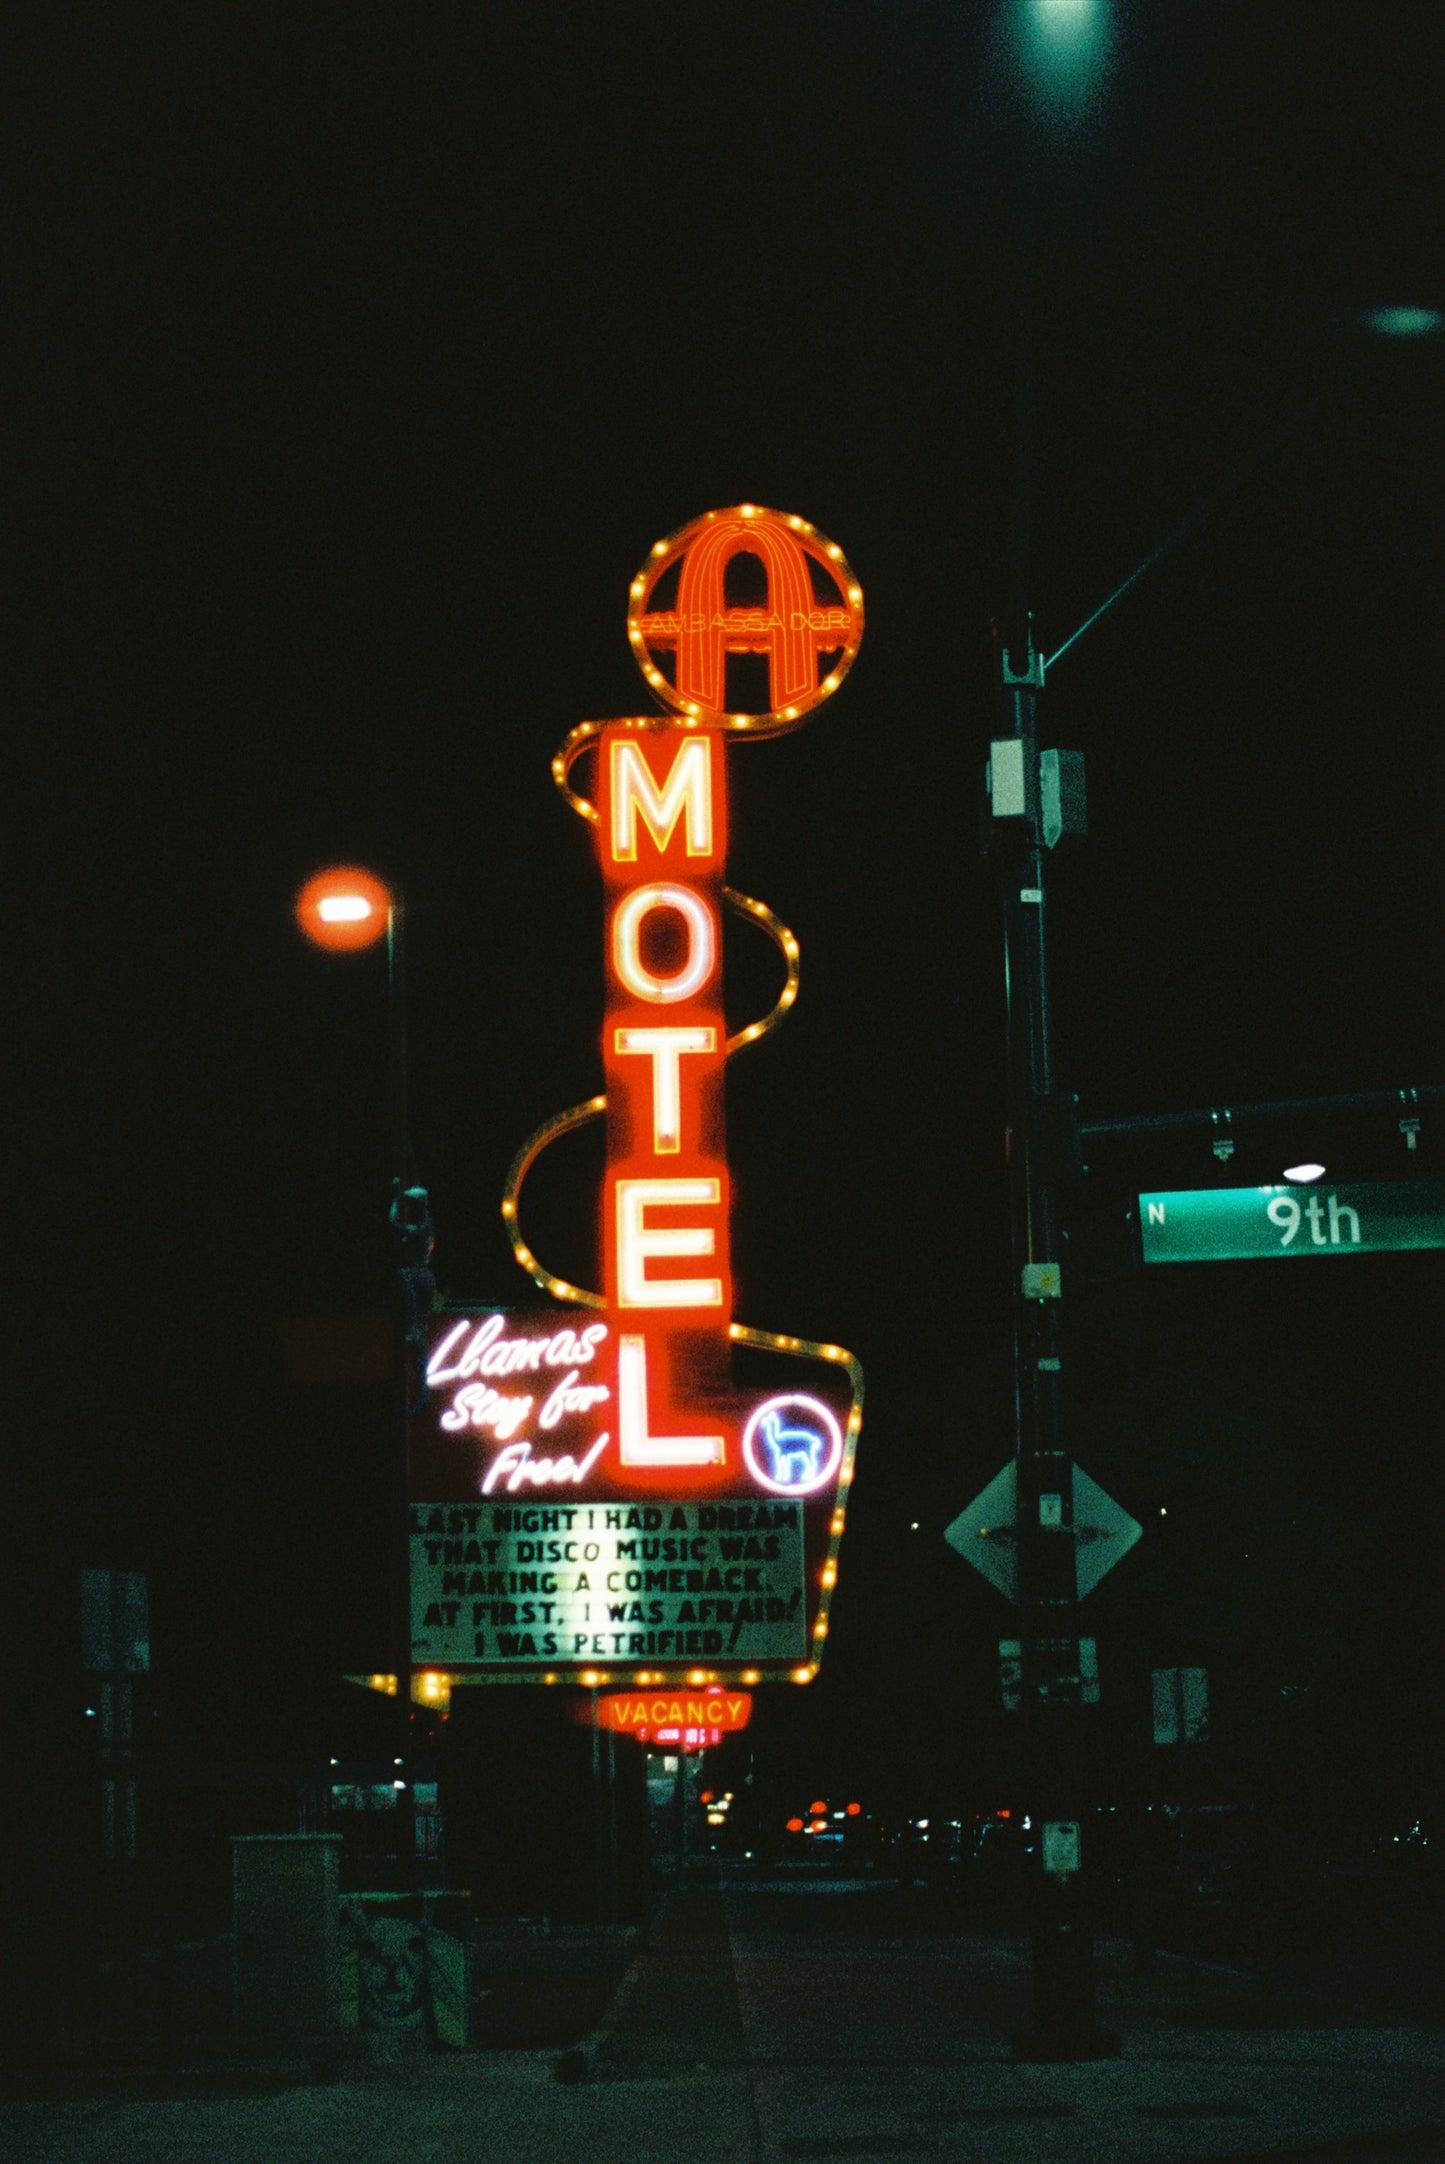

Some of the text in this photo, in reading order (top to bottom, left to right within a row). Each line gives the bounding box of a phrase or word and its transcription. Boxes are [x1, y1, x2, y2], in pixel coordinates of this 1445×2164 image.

[648, 612, 848, 633] AMBASSADOR
[607, 732, 727, 1468] MOTEL
[1147, 1194, 1361, 1247] N 9th
[425, 1313, 609, 1386] Llamas
[538, 1369, 610, 1430] for
[410, 1505, 799, 1533] LAST NIGHT I HAD A DREAM
[423, 1534, 781, 1565] THAT DISCO MUSIC WAS
[443, 1567, 775, 1596] MAKING A COMEBACK.
[423, 1601, 460, 1627] AT
[585, 1603, 591, 1622] I
[606, 1600, 664, 1624] WAS
[677, 1586, 803, 1624] AFRAID!
[475, 1622, 743, 1658] I WAS PETRIFIED!
[614, 1700, 742, 1724] VACANCY
